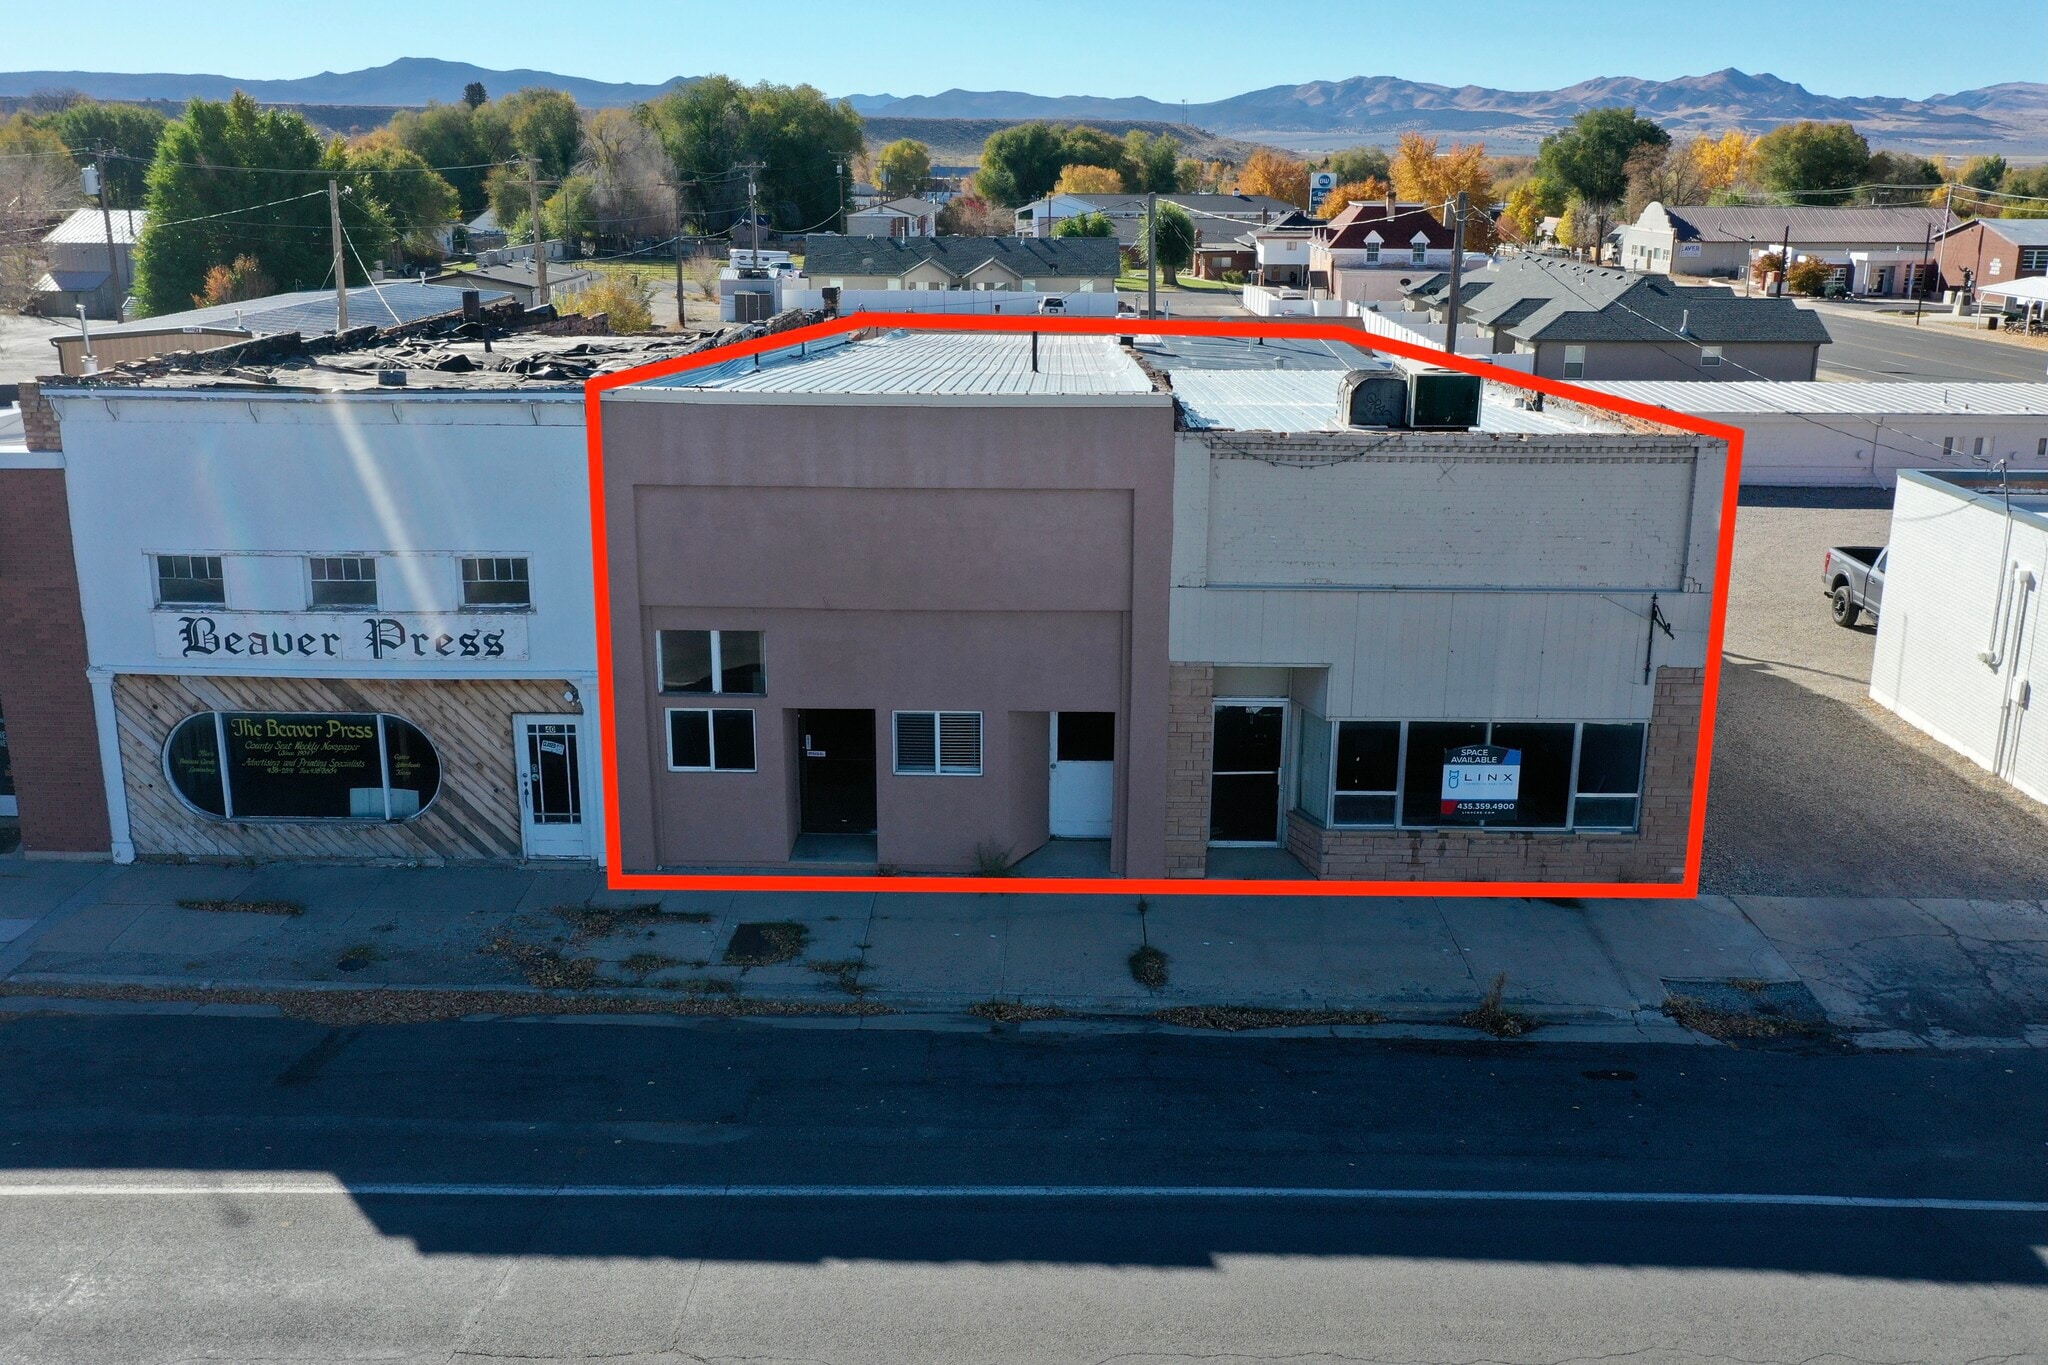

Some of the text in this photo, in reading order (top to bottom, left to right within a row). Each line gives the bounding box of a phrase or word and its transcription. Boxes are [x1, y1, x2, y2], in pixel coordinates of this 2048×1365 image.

[178, 616, 505, 660] Beaver Press
[231, 718, 374, 739] The Beaver Press
[244, 740, 274, 752] County
[274, 740, 293, 750] Seat
[283, 758, 297, 767] and
[297, 757, 327, 768] Printing
[328, 758, 366, 768] Specialists
[1450, 756, 1498, 764] AVAILABLE
[1464, 773, 1513, 782] LINX
[1457, 802, 1515, 810] 435.359.4900
